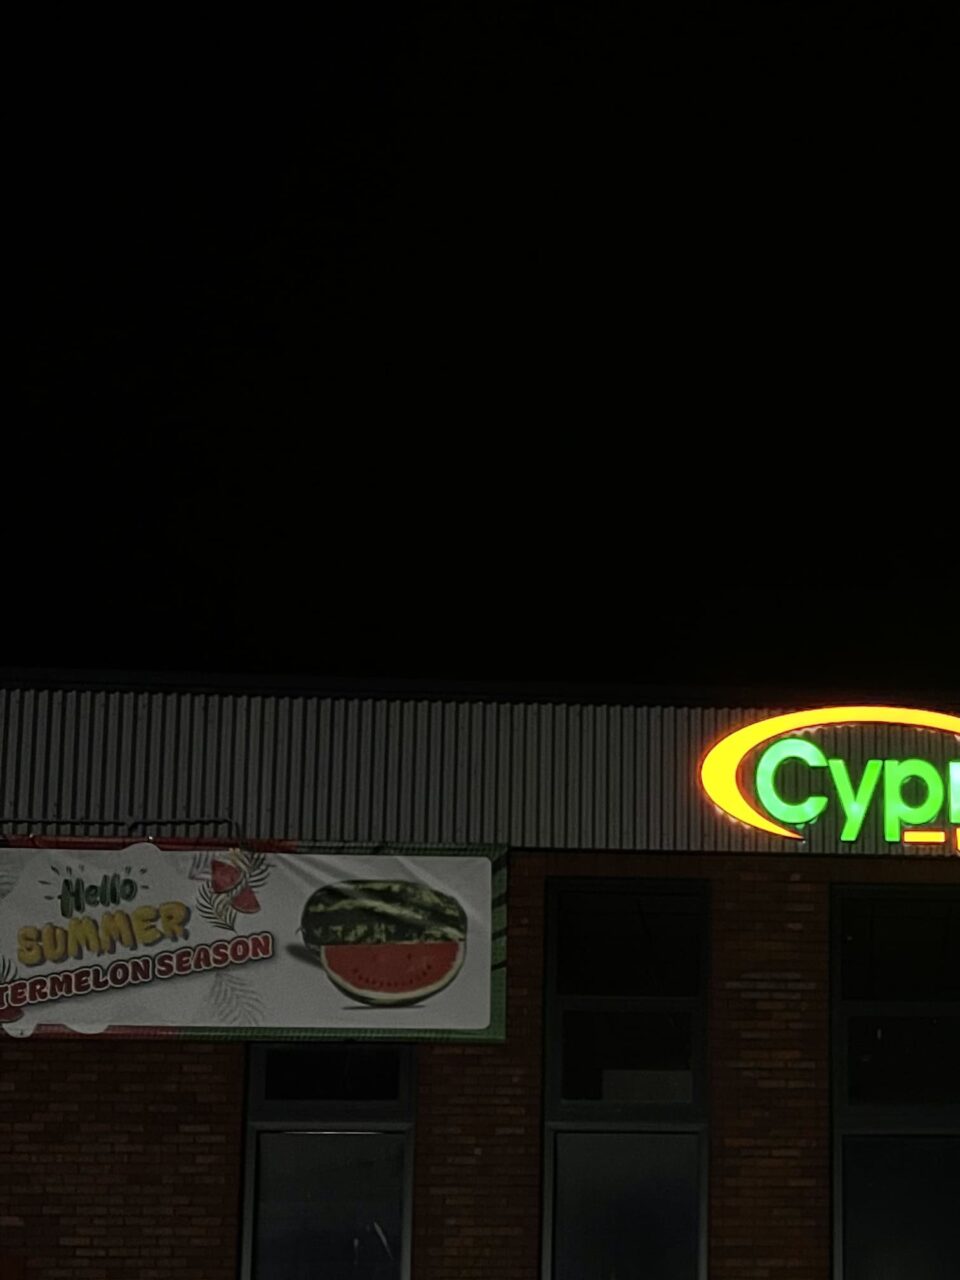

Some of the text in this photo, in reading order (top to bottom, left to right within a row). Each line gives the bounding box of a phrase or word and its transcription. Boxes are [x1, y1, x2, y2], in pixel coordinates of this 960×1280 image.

[59, 874, 138, 917] Hello
[17, 901, 191, 966] SUMMER
[155, 934, 272, 976] SEASON
